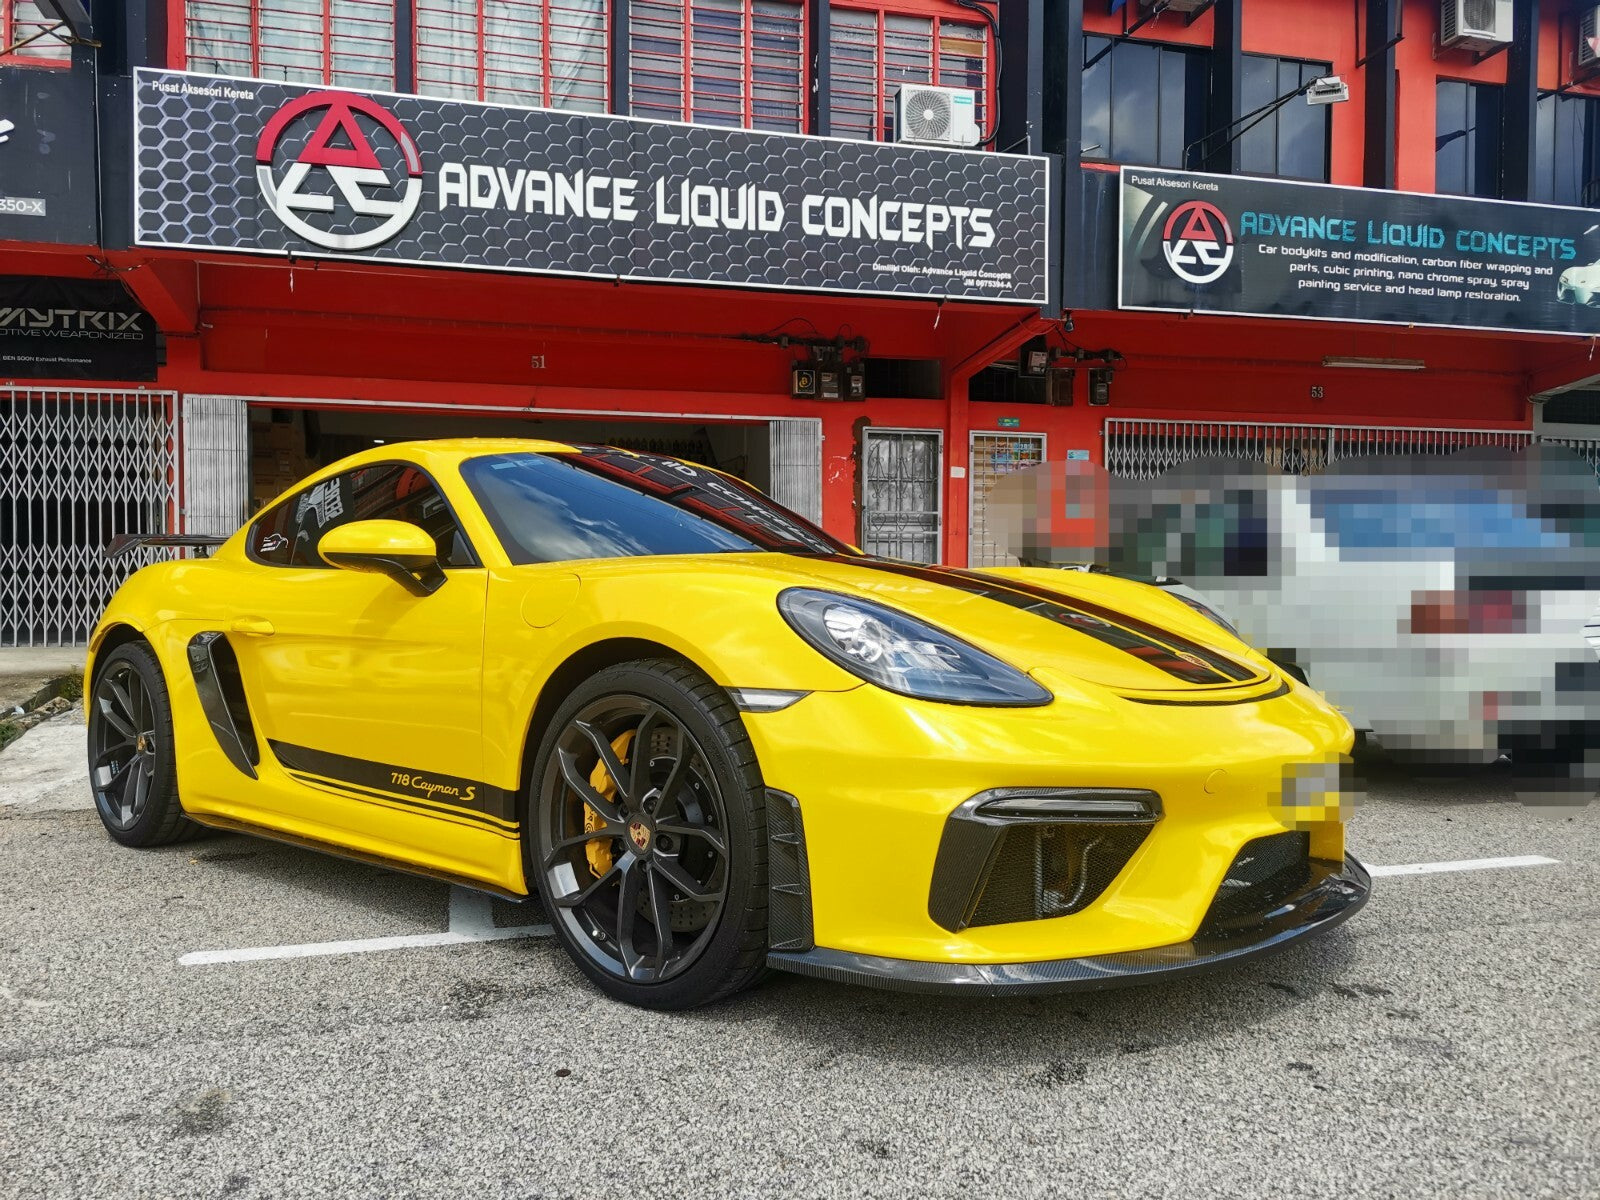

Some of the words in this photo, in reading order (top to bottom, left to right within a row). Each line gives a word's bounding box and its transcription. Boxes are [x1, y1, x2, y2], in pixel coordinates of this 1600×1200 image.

[152, 81, 180, 92] Pusat
[181, 83, 221, 98] Aksesori
[224, 87, 254, 100] Kereta
[1131, 175, 1155, 186] Pusat
[1156, 177, 1191, 189] Aksesori
[1192, 181, 1219, 191] Kereta
[439, 162, 639, 222] ADVANCE
[656, 176, 785, 232] LIQUID
[801, 194, 996, 250] CONCEPTS
[1240, 211, 1357, 242] ADVANCE
[1367, 219, 1446, 249] LIQUID
[1456, 230, 1577, 260] CONCEPTS
[1258, 244, 1277, 254] Car
[1281, 245, 1328, 259] bodykits
[1331, 249, 1351, 260] and
[1354, 253, 1419, 267] modification,
[1422, 257, 1457, 269] carbon
[1459, 259, 1482, 270] fiber
[1486, 262, 1532, 276] wrapping
[1534, 265, 1553, 275] and
[922, 266, 953, 276] Advance
[954, 268, 977, 279] Liquid
[978, 270, 1012, 280] Concepts
[1289, 262, 1320, 275] parts,
[1323, 264, 1350, 275] cubic
[1353, 267, 1395, 280] printing,
[1398, 271, 1424, 281] nano
[1427, 272, 1464, 284] chrome
[1467, 276, 1498, 288] spray,
[1501, 278, 1530, 290] spray
[963, 279, 974, 288] JM
[1298, 279, 1340, 291] painting
[1343, 282, 1381, 293] service
[1385, 284, 1405, 294] and
[1408, 286, 1434, 296] head
[1437, 287, 1462, 299] lamp
[1464, 290, 1521, 301] restoration.
[42, 329, 143, 340] WEAPONIZED
[531, 355, 546, 369] 51
[1311, 386, 1324, 398] 53
[391, 772, 410, 786] 718
[411, 776, 459, 798] Cayman
[459, 786, 476, 801] S
